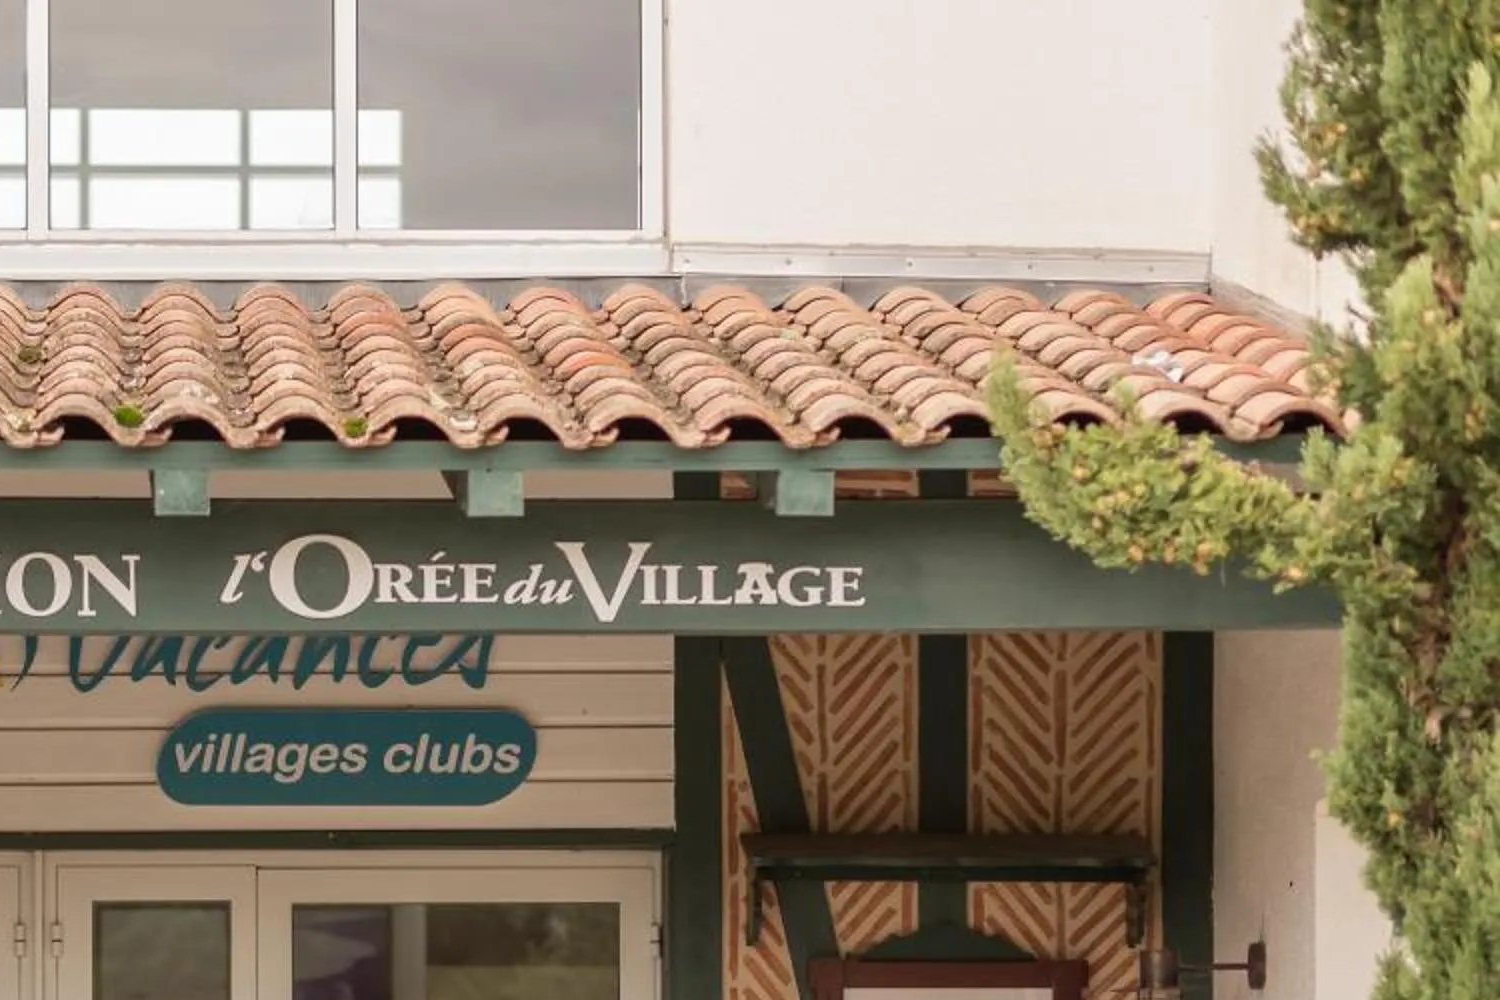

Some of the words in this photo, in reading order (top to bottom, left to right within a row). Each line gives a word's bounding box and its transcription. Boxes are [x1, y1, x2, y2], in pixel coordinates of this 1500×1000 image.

[553, 541, 867, 622] VILLAGE
[174, 733, 368, 784] villages
[383, 733, 521, 774] clubs
